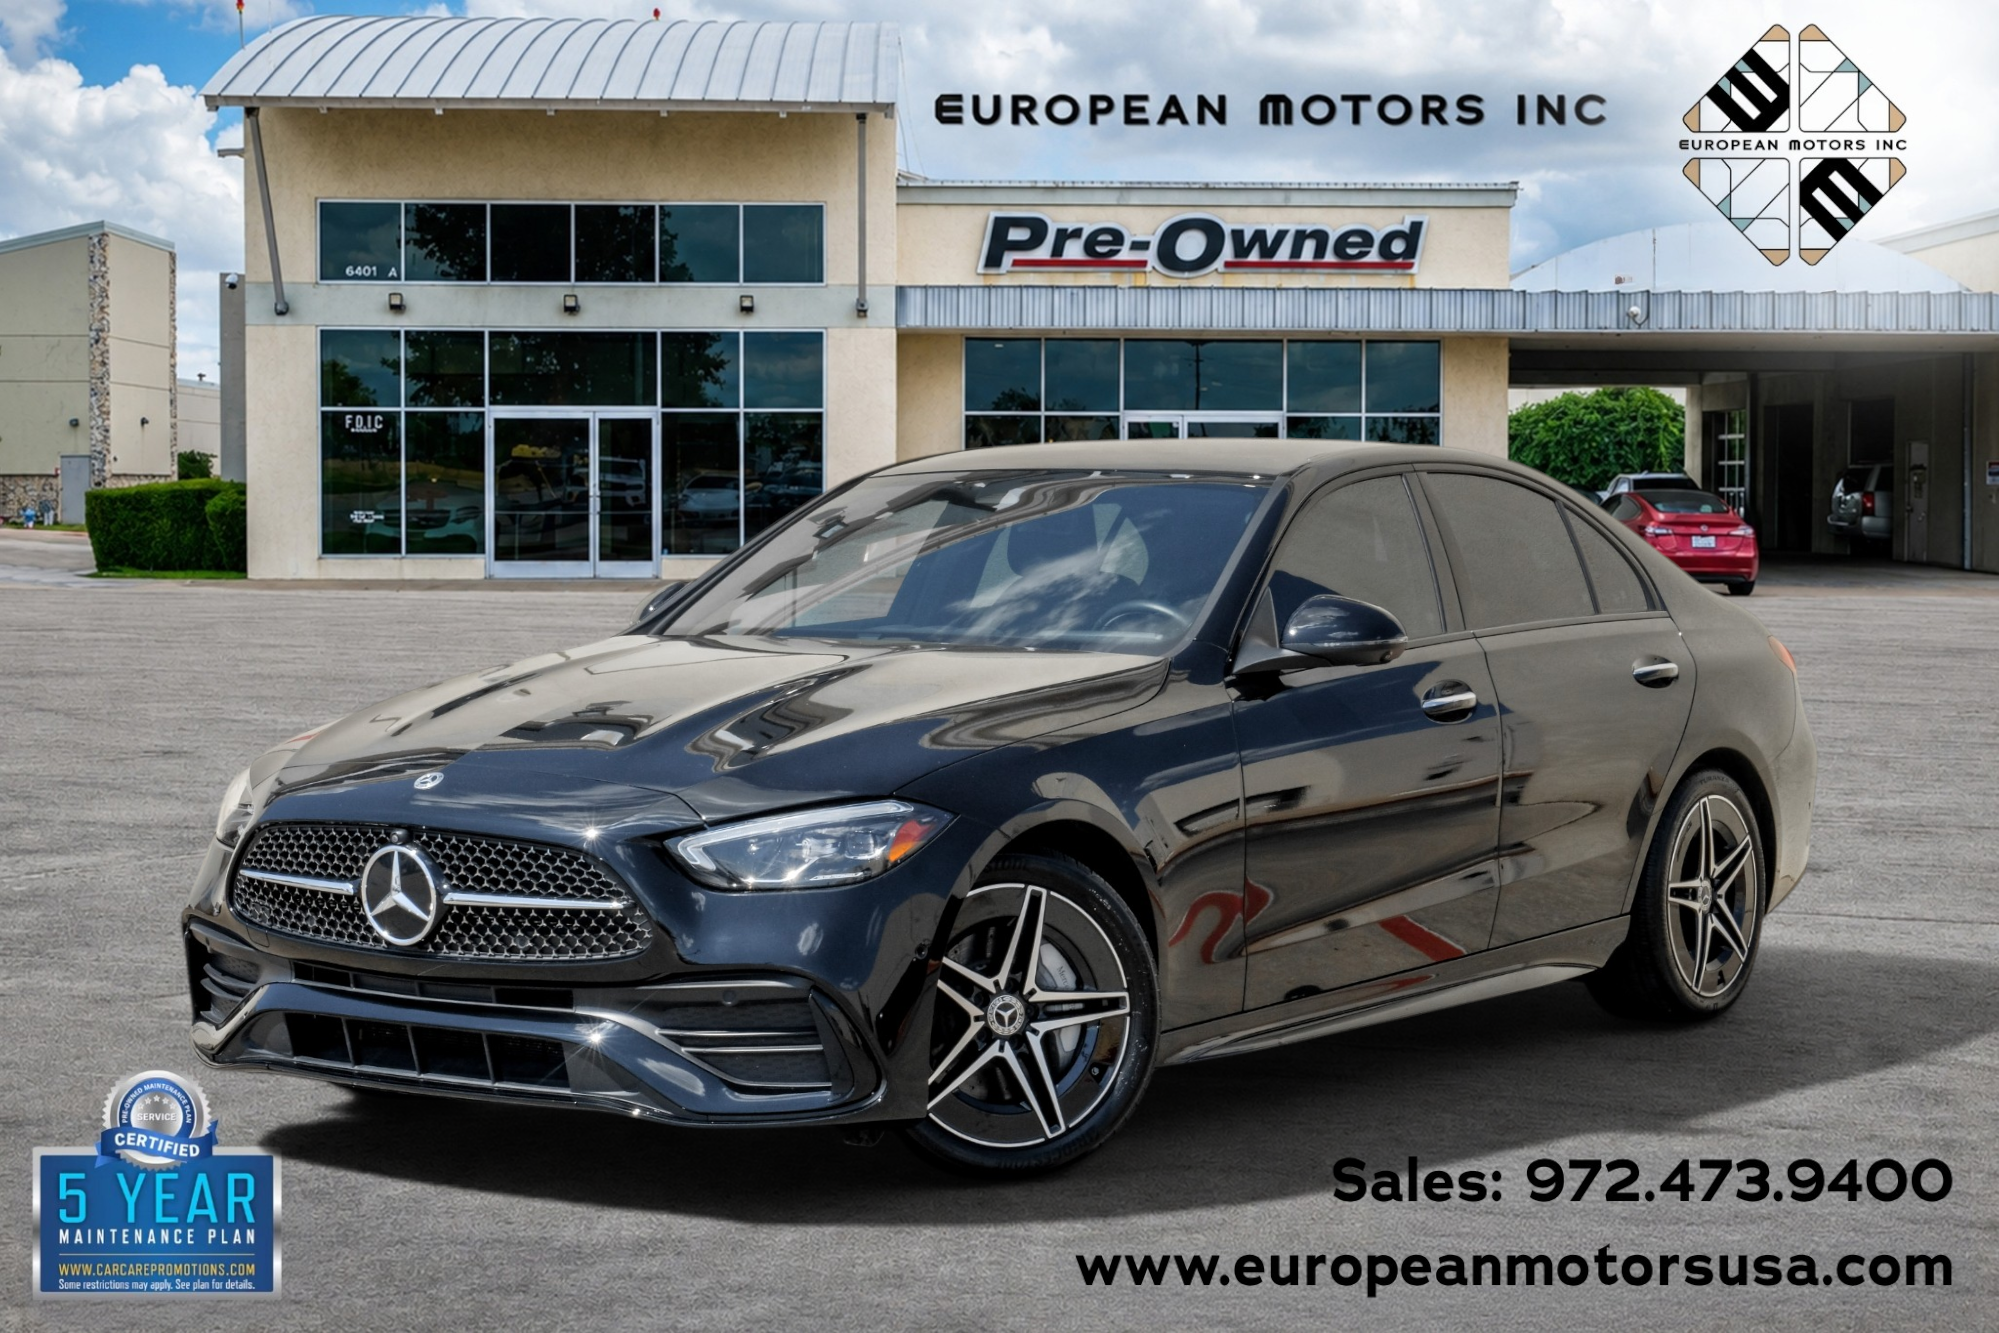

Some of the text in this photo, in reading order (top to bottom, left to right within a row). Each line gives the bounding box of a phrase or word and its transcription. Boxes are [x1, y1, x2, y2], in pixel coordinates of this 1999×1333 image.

[983, 215, 1423, 272] Pre-Owned
[345, 265, 398, 278] 6401 A
